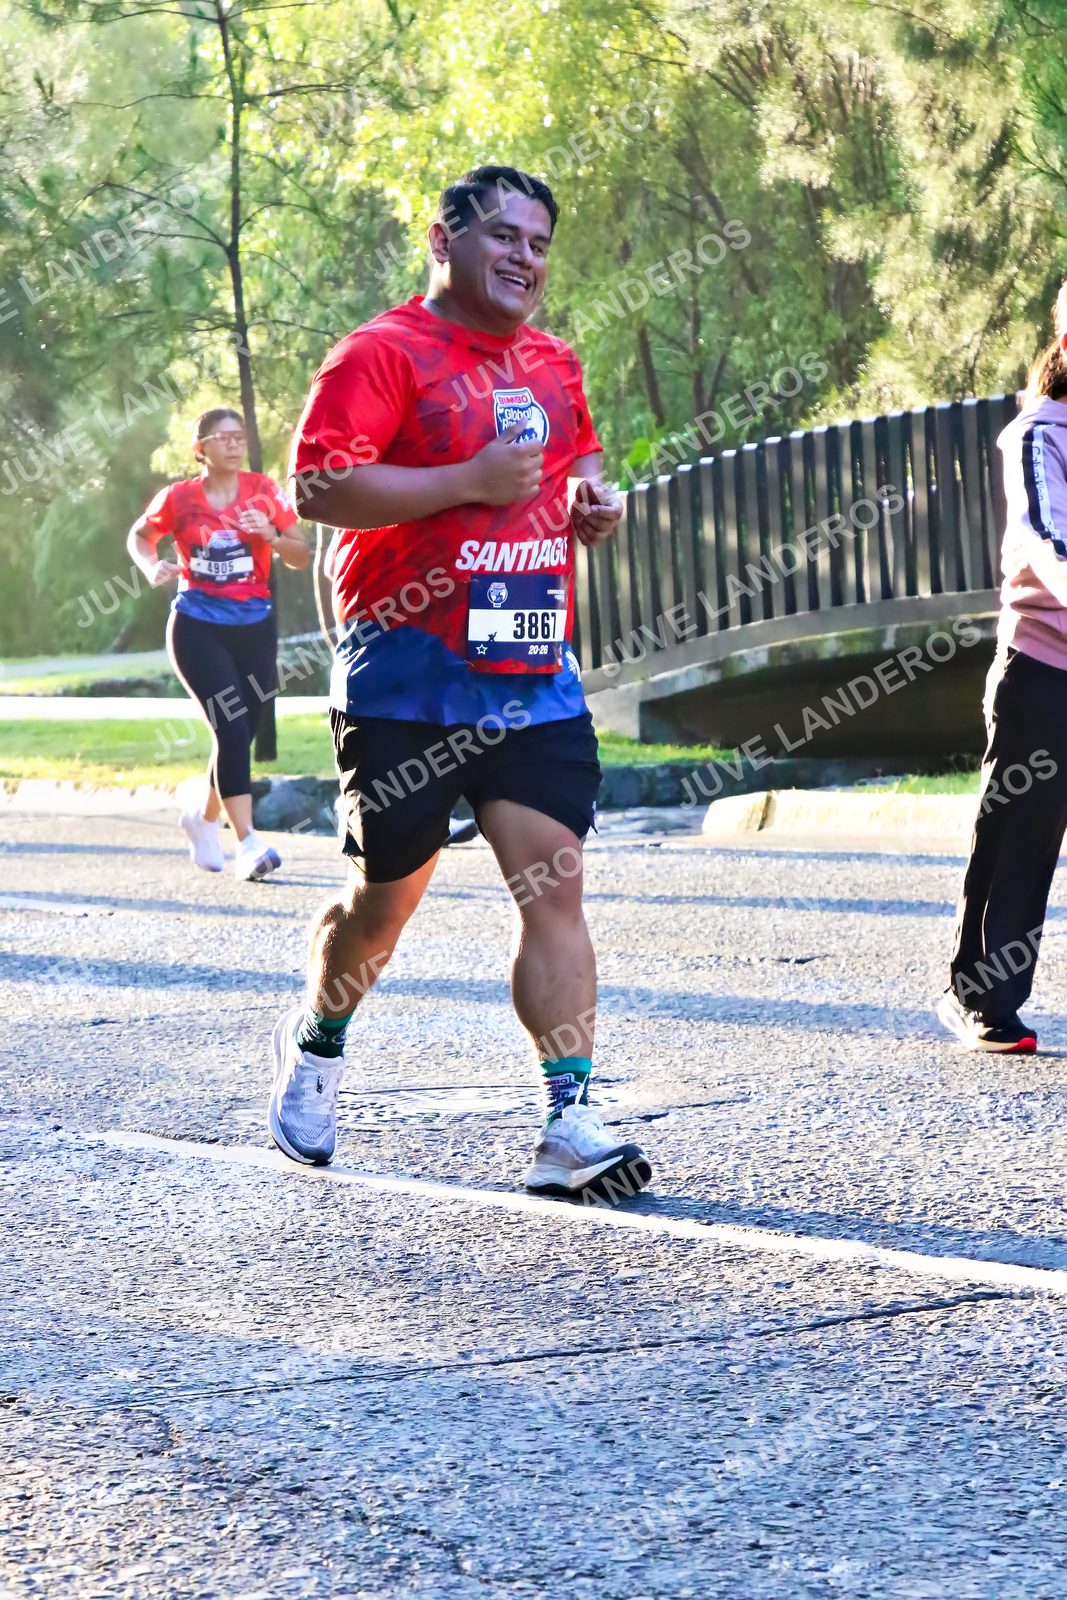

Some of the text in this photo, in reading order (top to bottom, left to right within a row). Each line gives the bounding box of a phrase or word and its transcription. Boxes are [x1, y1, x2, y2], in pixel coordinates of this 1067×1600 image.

[498, 395, 529, 404] BIMBO
[504, 407, 531, 420] Global
[455, 537, 568, 572] SANTIAGO
[207, 561, 234, 574] 4905
[513, 612, 557, 640] 3867
